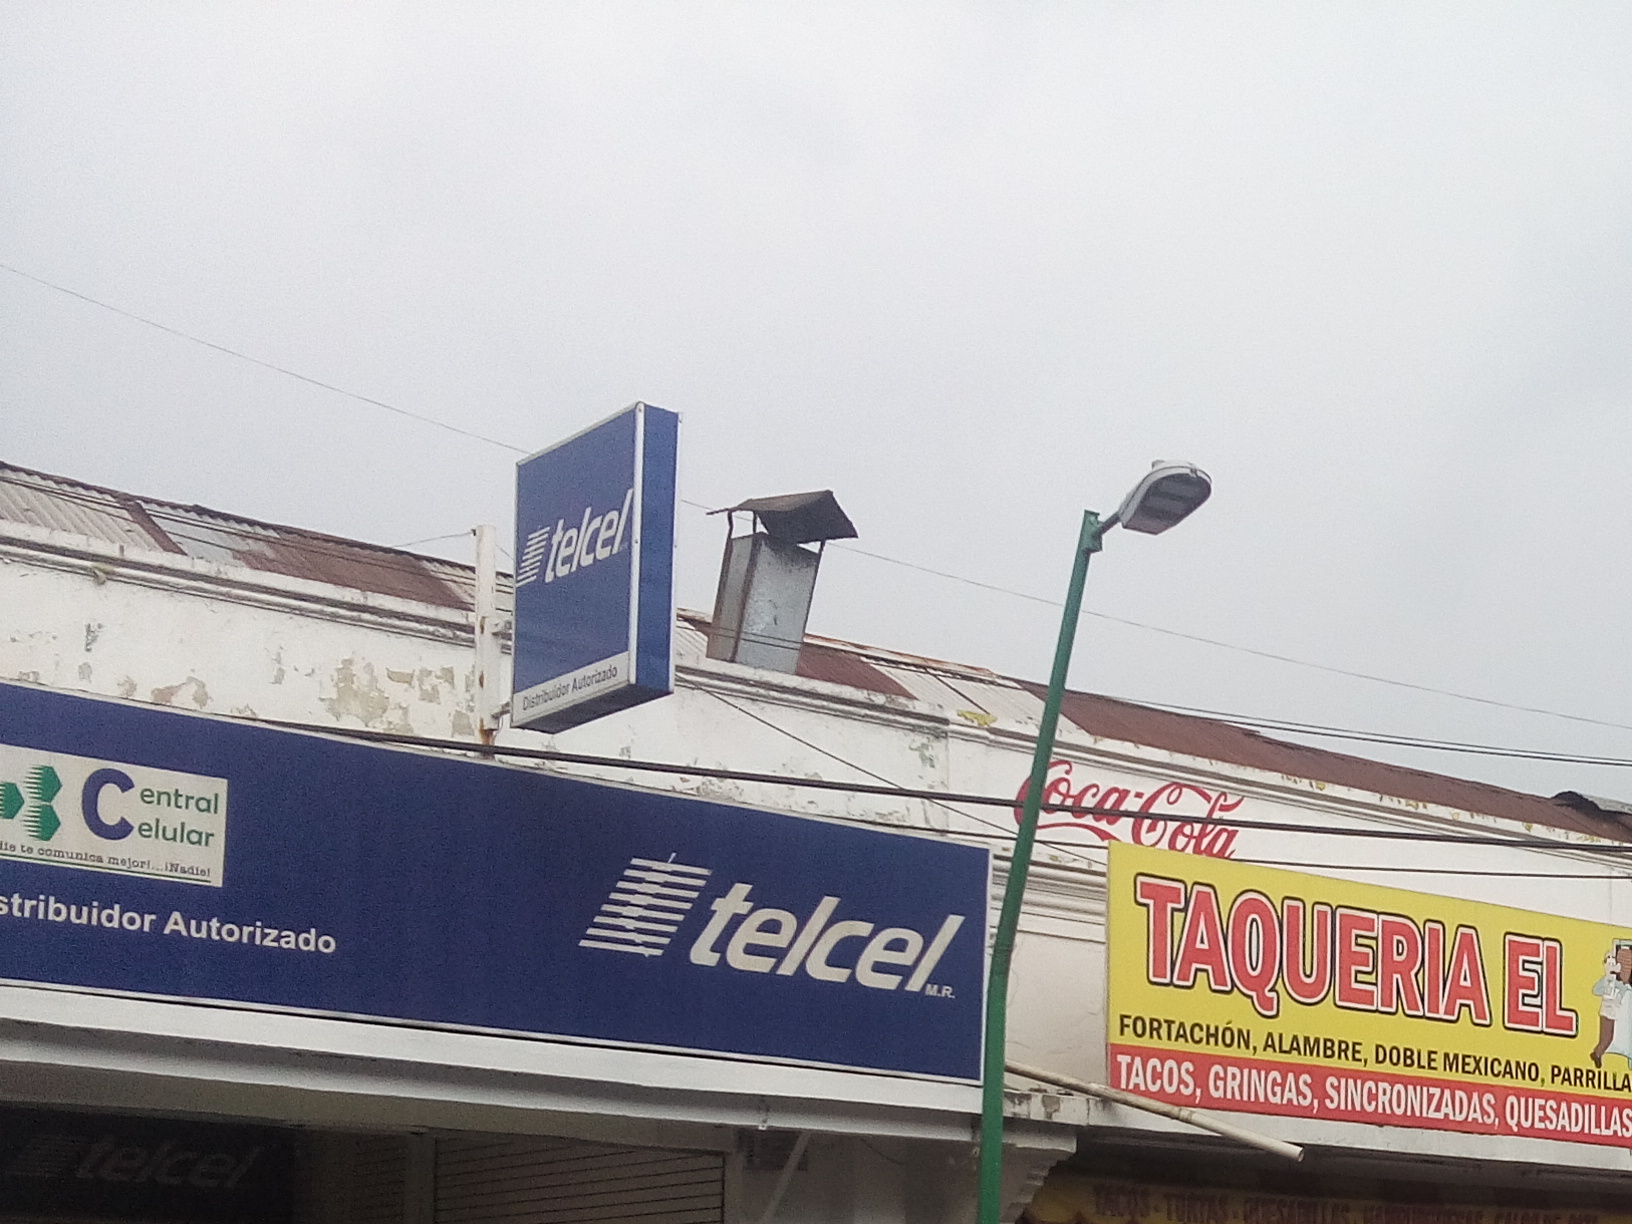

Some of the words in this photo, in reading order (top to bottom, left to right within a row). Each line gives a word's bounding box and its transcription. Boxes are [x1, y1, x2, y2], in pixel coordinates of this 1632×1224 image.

[546, 488, 634, 583] telcel
[572, 664, 618, 693] Autorizado
[20, 843, 34, 855] te
[38, 846, 104, 864] comunica
[163, 910, 337, 954] Autorizado
[689, 883, 965, 992] telcel
[1135, 874, 1491, 1028] TAQUERIA
[1503, 932, 1578, 1038] EL
[1119, 1014, 1258, 1055] FORTACHÓN,
[1263, 1031, 1369, 1068] ALAMBRE,
[1374, 1044, 1437, 1071] DOBLE
[1443, 1053, 1546, 1087] MEXICANO,
[1116, 1054, 1202, 1103] TACOS,
[1208, 1065, 1318, 1114] GRINGAS,
[1324, 1077, 1500, 1129] SINCRONIZADAS,
